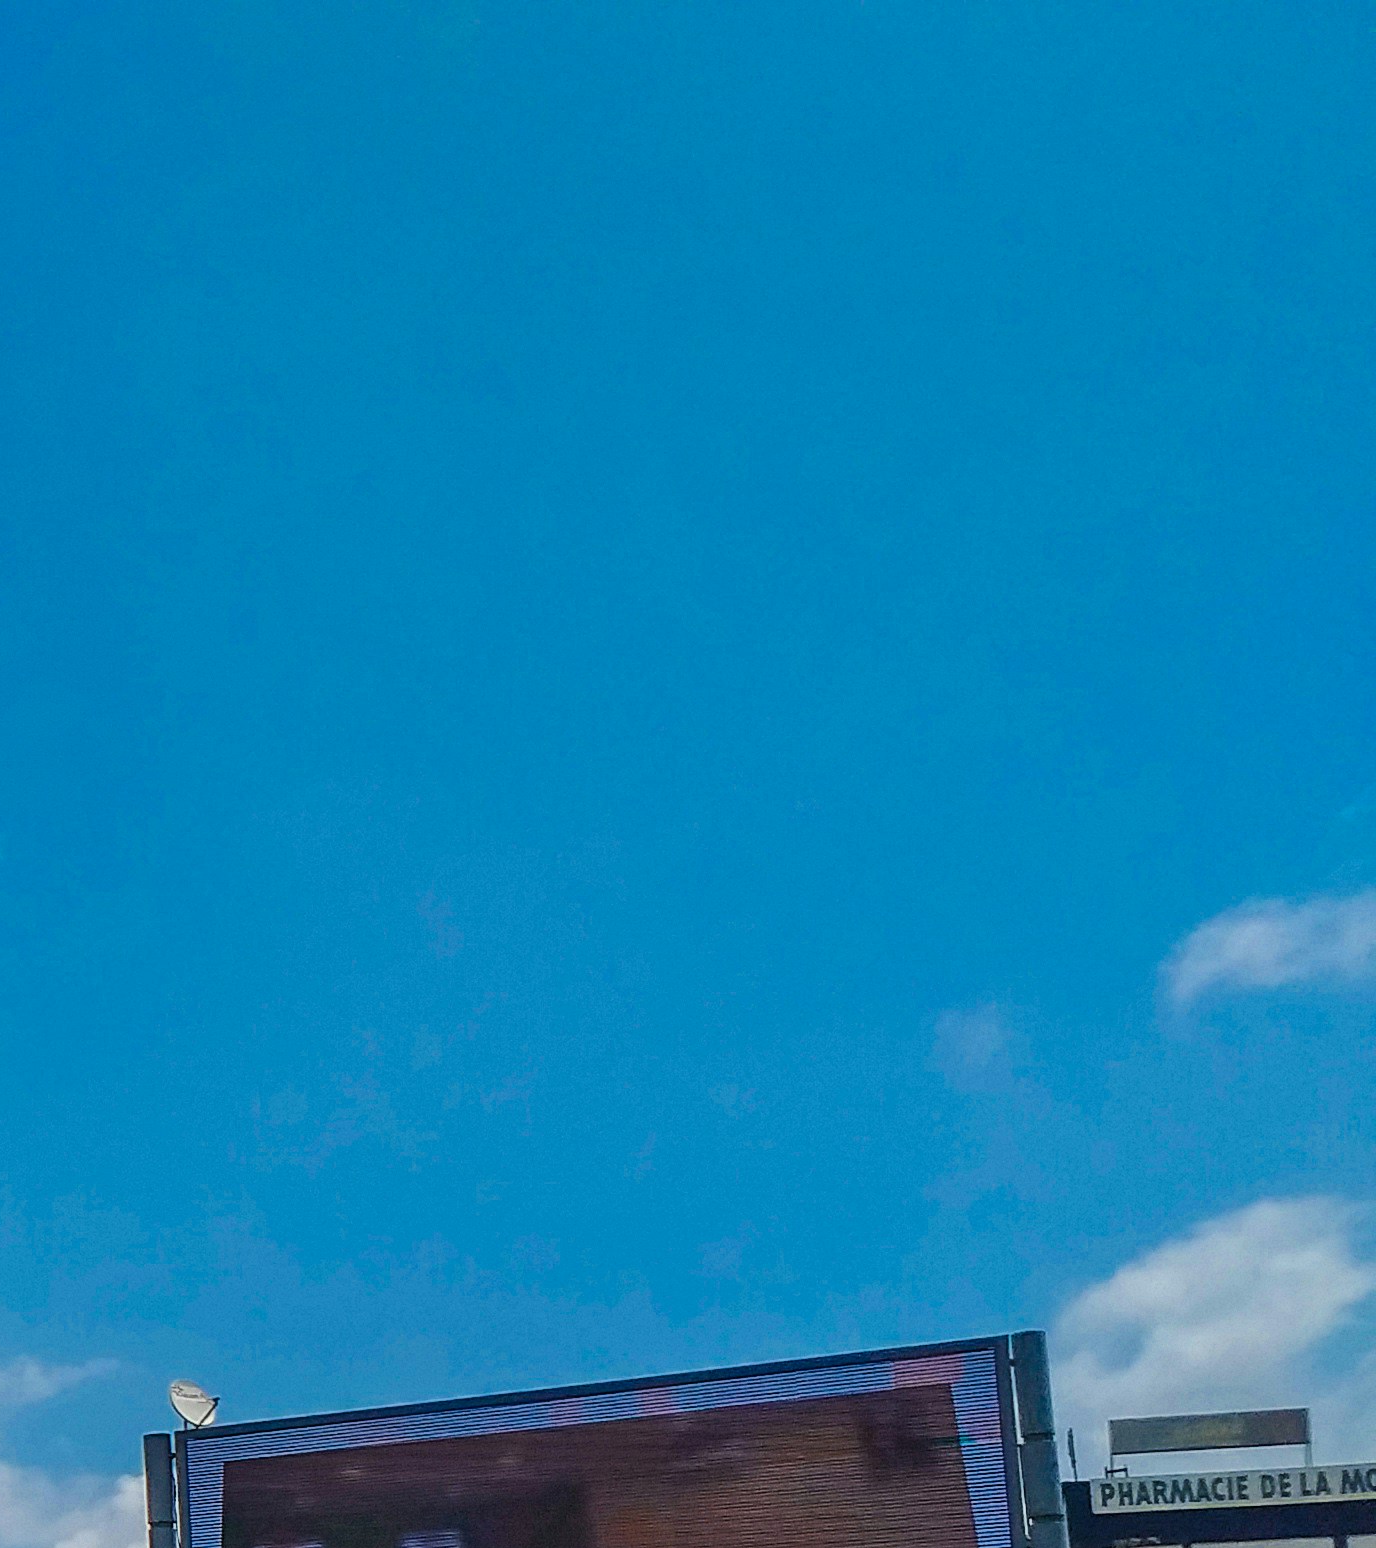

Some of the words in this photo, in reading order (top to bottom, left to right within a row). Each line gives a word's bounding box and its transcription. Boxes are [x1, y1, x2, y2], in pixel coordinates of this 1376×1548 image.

[1099, 1474, 1250, 1508] PHARMACIE
[1260, 1472, 1292, 1499] DE
[1299, 1470, 1331, 1497] LA
